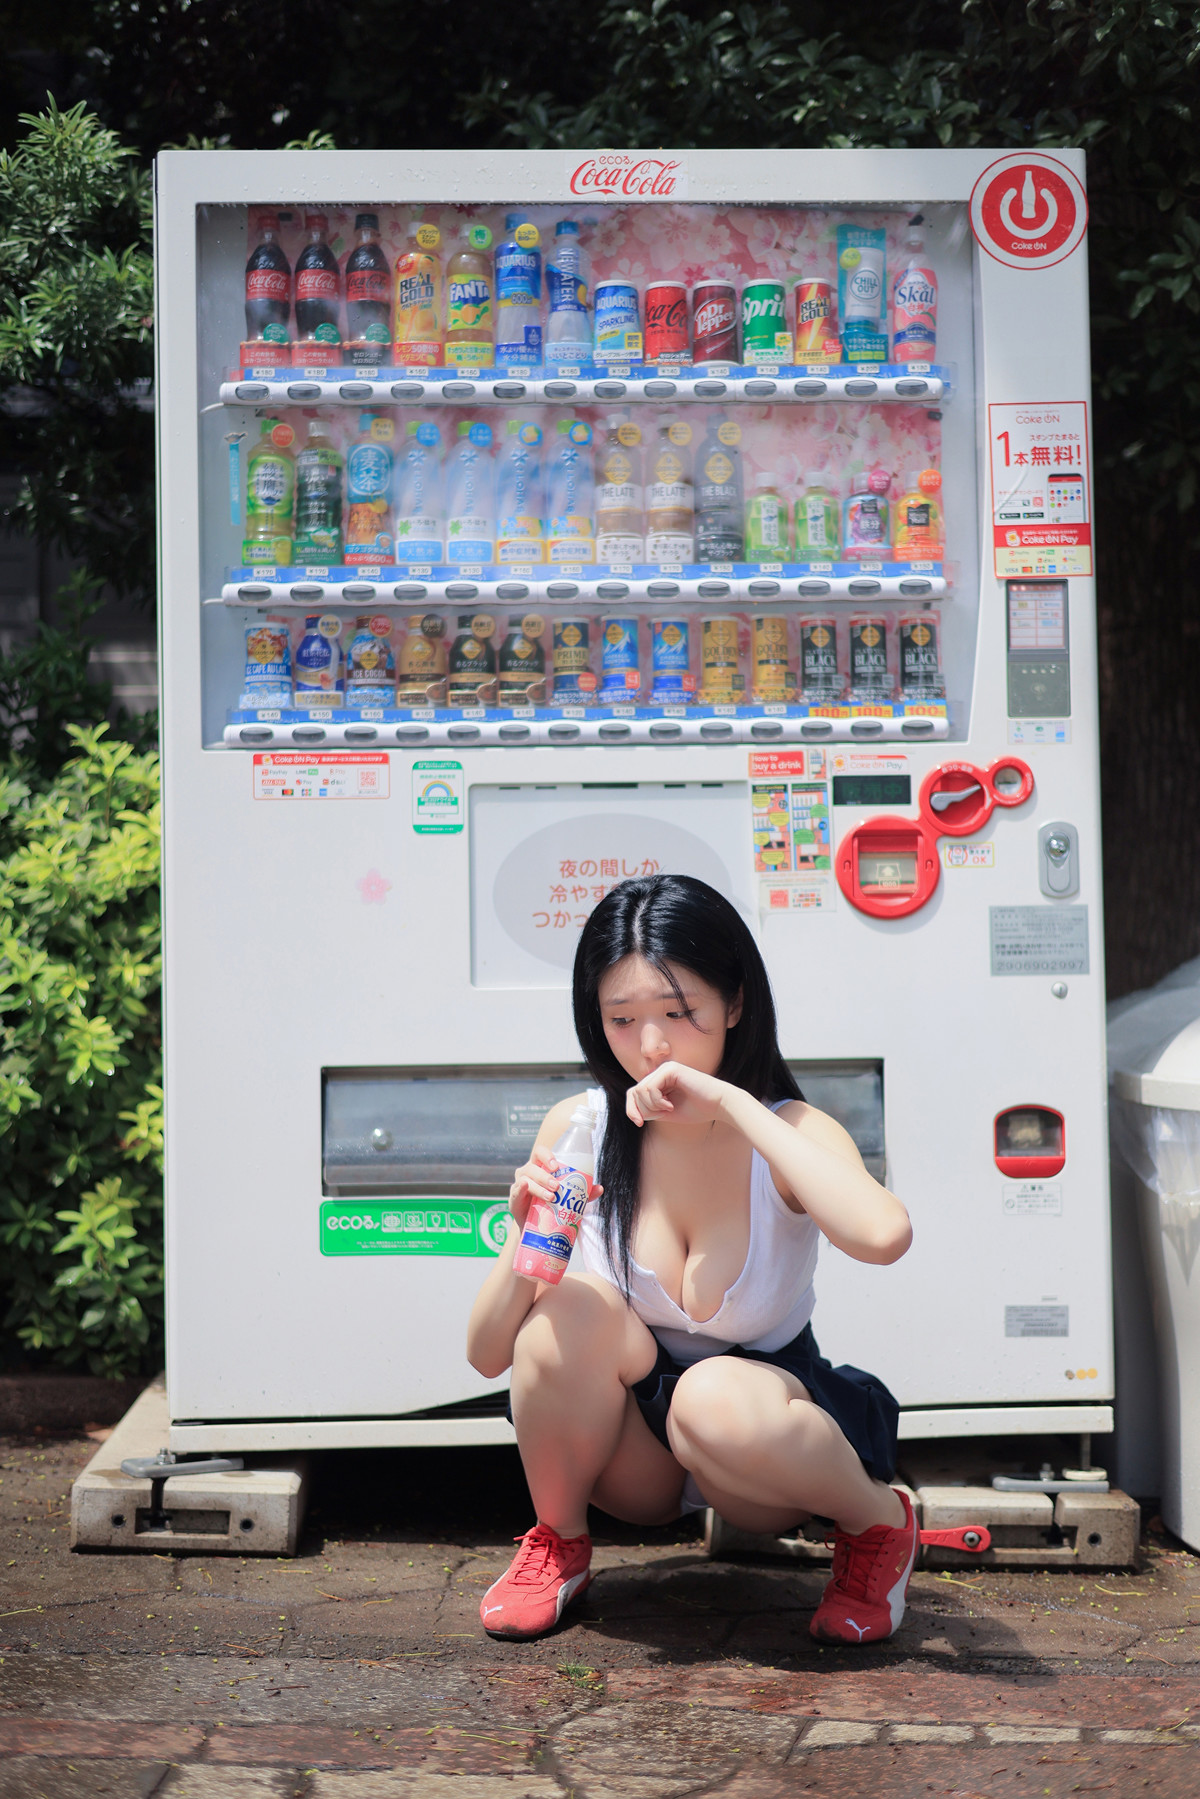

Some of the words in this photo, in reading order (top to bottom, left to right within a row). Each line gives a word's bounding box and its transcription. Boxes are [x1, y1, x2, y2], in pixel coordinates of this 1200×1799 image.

[1011, 241, 1033, 250] Coke
[400, 271, 434, 291] REAL
[854, 276, 879, 286] CHILL
[857, 285, 875, 294] OUT
[400, 287, 434, 306] GOLD
[706, 303, 725, 316] Dr
[800, 295, 830, 312] REAL
[800, 305, 830, 325] GOLD
[696, 310, 734, 335] Pepper
[1016, 414, 1042, 425] Coke
[1044, 413, 1060, 424] ON
[601, 487, 614, 497] THE
[651, 487, 665, 497] THE
[1022, 535, 1045, 544] Coke
[1060, 534, 1079, 546] Pay
[805, 655, 837, 668] BLACK
[854, 655, 887, 667] BLACK
[904, 654, 937, 666] BLACK
[306, 756, 320, 765] Pay
[778, 761, 802, 770] drink
[850, 761, 871, 770] Coke
[886, 762, 904, 771] Pay
[559, 858, 660, 879] 夜の間しか
[549, 884, 620, 904] 冷やす
[558, 1208, 577, 1225] 白桃
